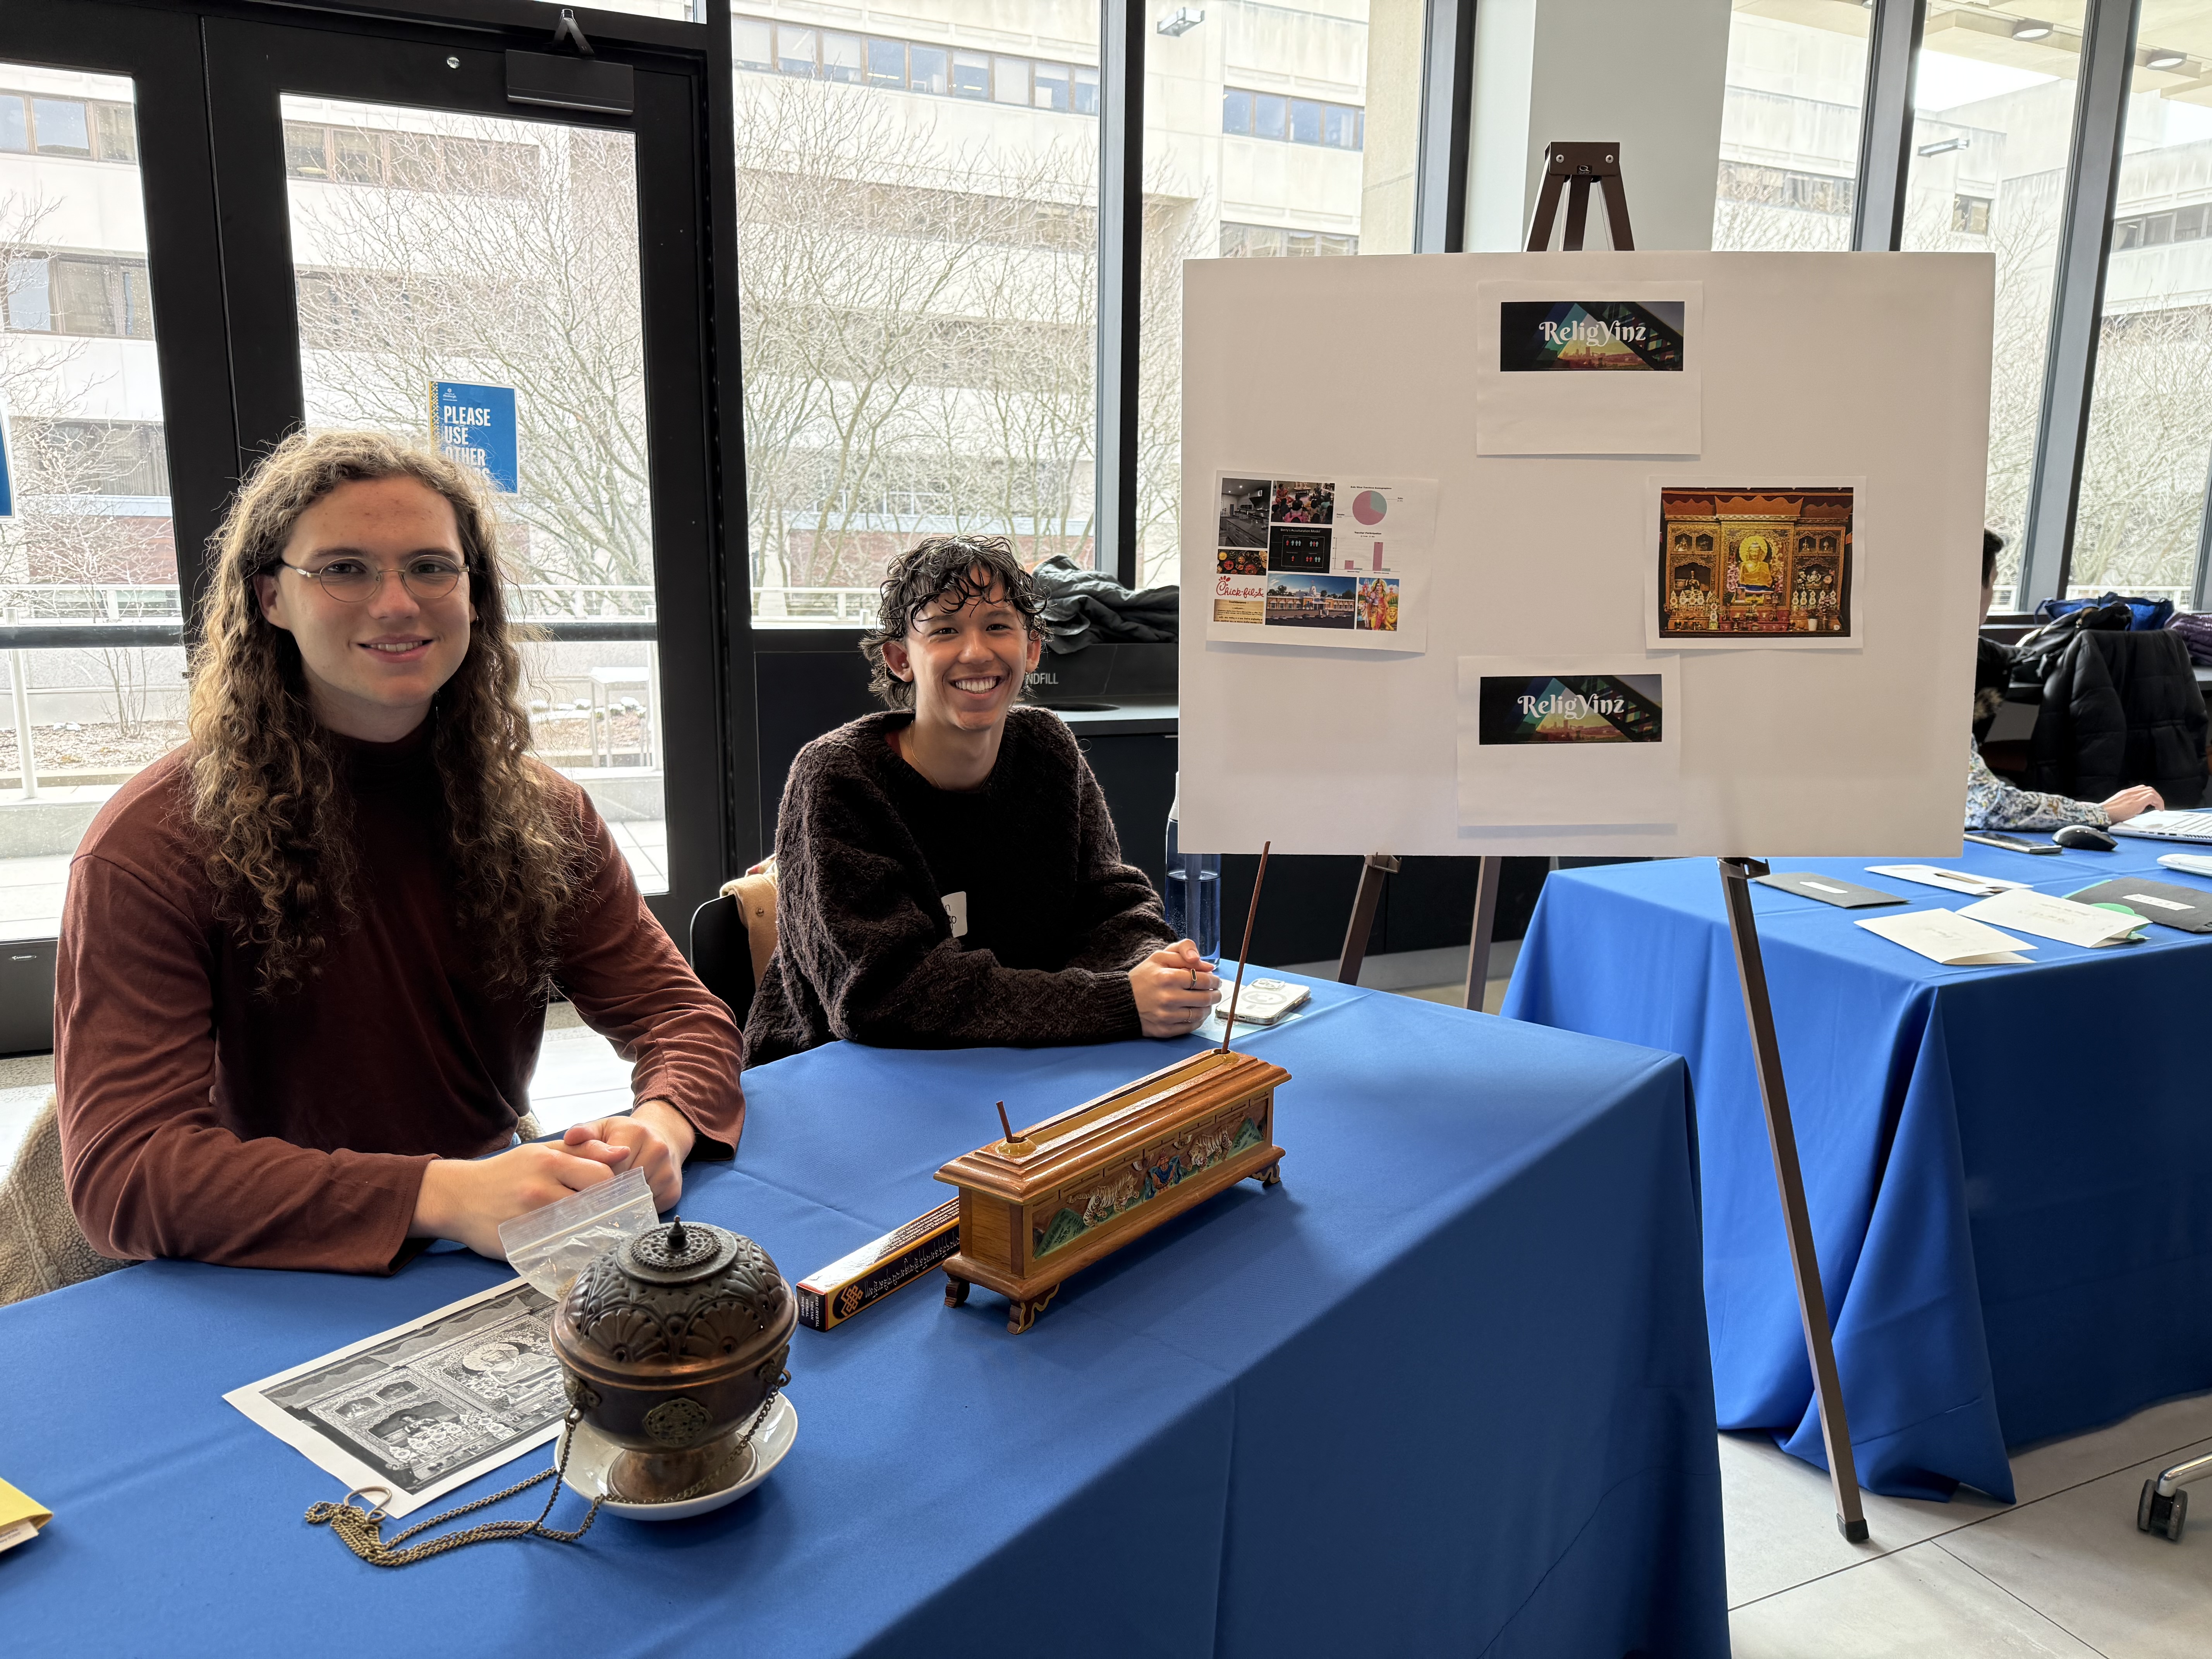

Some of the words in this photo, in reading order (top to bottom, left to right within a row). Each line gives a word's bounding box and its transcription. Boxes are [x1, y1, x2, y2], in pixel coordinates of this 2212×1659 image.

[1539, 320, 1646, 347] ReligYinz
[444, 405, 491, 426] PLEASE
[445, 426, 469, 445] USE
[1216, 580, 1264, 598] Chick-fil-A
[1026, 673, 1059, 684] NDFILL
[1517, 694, 1625, 720] ReligYinz
